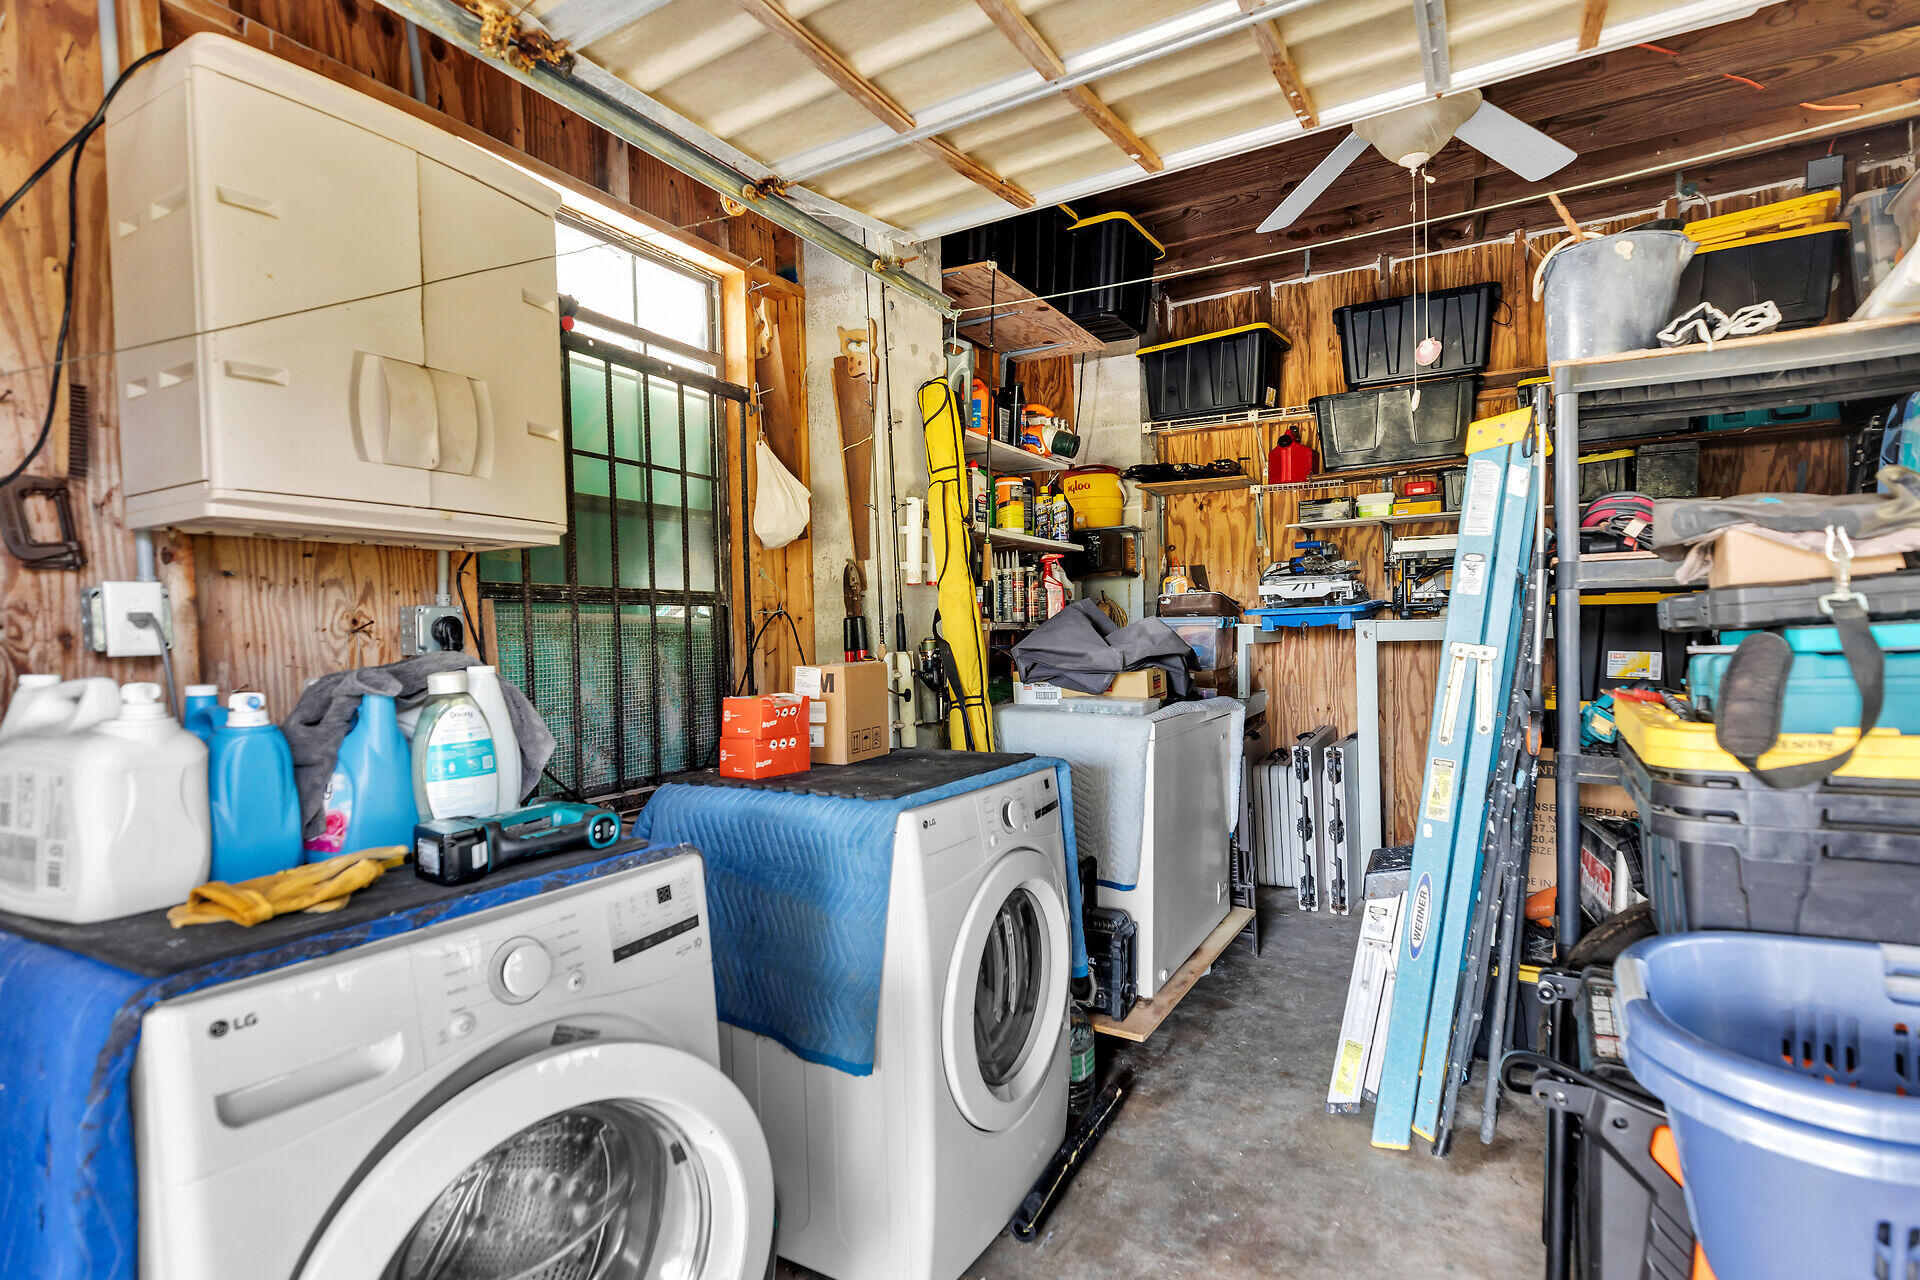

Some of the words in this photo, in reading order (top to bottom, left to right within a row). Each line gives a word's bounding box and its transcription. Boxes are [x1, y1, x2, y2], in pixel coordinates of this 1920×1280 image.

[1067, 480, 1091, 494] igloo
[1534, 803, 1556, 812] NSE
[1579, 805, 1638, 818] FIREPLAC
[927, 818, 936, 827] LG
[1413, 890, 1428, 941] WERNER
[233, 1012, 257, 1030] LG
